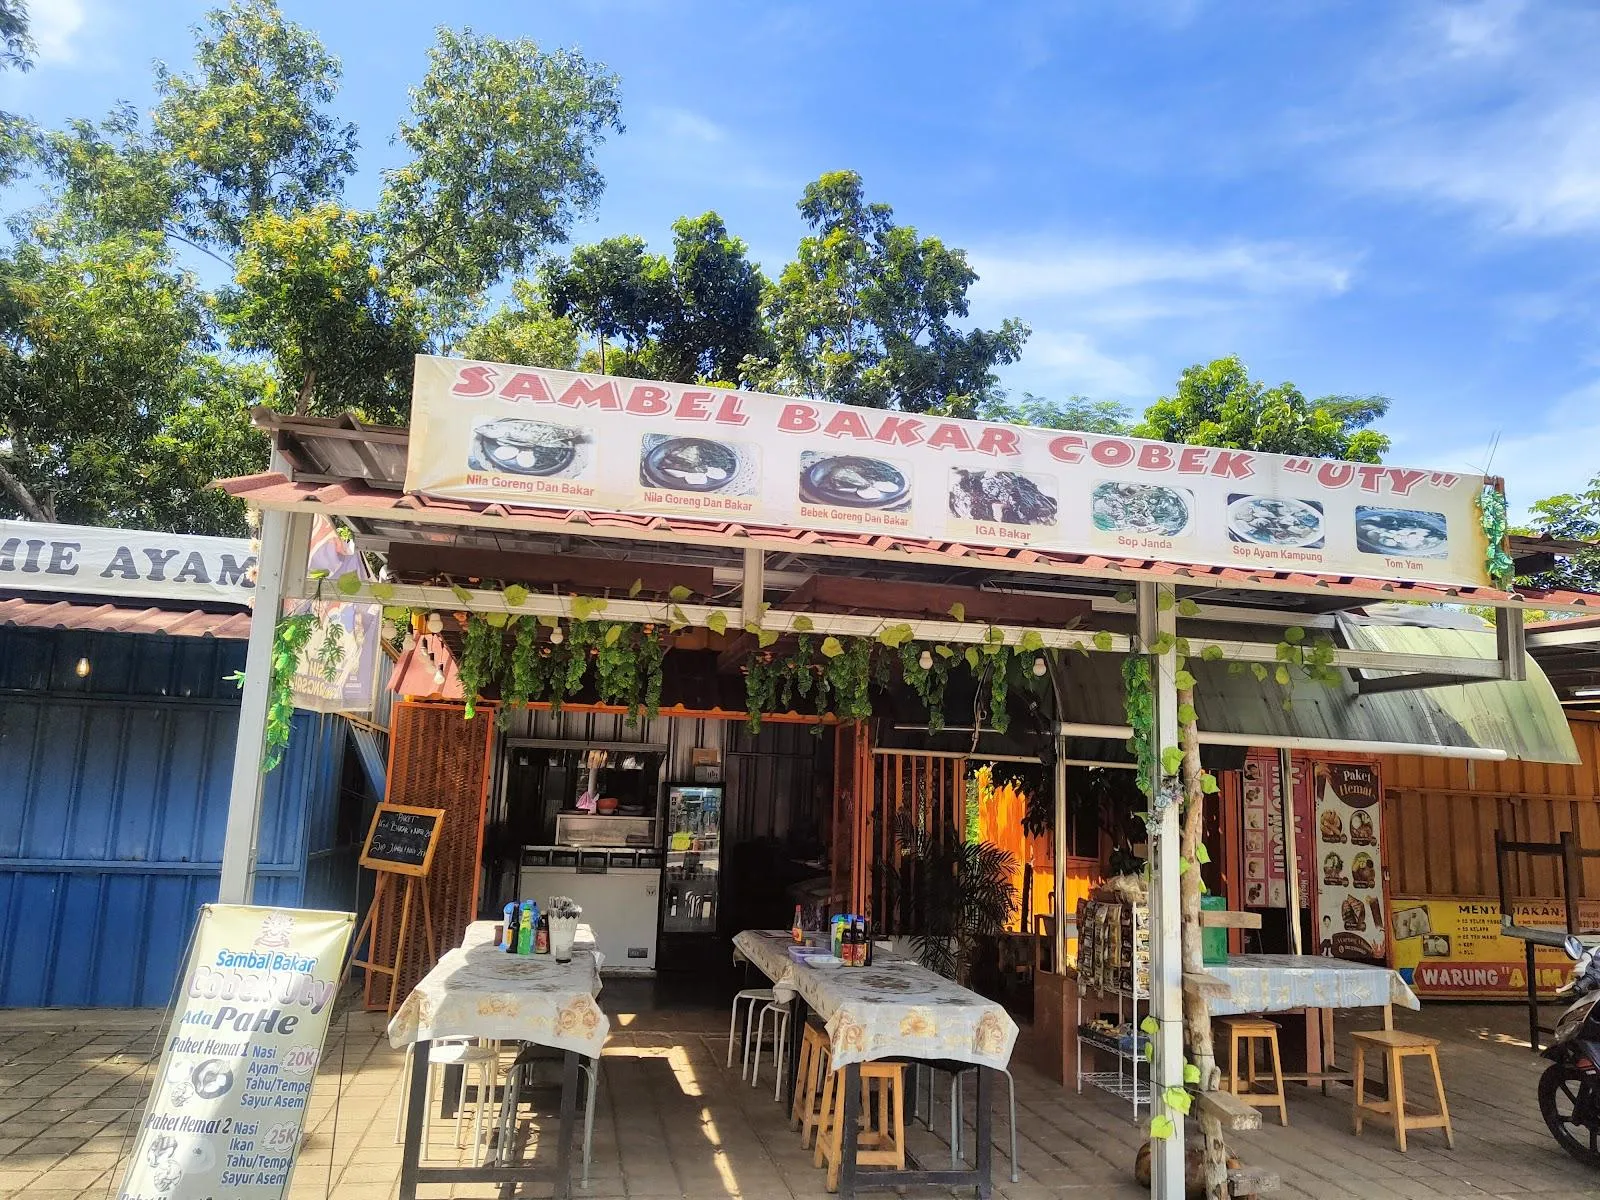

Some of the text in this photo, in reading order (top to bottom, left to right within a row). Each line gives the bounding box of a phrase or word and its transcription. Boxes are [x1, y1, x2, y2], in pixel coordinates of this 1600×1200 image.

[452, 366, 750, 425] SAMBEL
[776, 404, 1021, 457] BAKAR
[1047, 435, 1255, 480] COBEK
[466, 474, 595, 497] Nila Goreng Dan Bakar
[643, 491, 753, 511] Nila Goreng Dan Bakar
[801, 506, 909, 527] Bebek Goreng Dan Bakar
[975, 525, 1031, 540] IGA Bakar
[1118, 536, 1173, 549] Sop Janda
[1233, 545, 1323, 563] Sop Ayam Kampung
[100, 545, 257, 588] AYAM
[1384, 558, 1424, 571] Tom Yam
[1343, 768, 1371, 783] Paket
[215, 948, 317, 973] Sambal Bakar
[1421, 967, 1499, 987] WARUNG
[180, 1006, 299, 1035] Ada PaHe
[168, 1036, 249, 1057] Paket Hemat 1
[252, 1045, 277, 1059] Nasi
[287, 1051, 315, 1067] 20K
[248, 1061, 278, 1075] Ayam
[245, 1077, 311, 1094] Tahu/Tempe
[240, 1093, 304, 1109] Sayur Asem
[145, 1113, 232, 1135] Paket Hemat 2
[233, 1121, 259, 1136] Nasi
[229, 1138, 254, 1152] Ikan
[269, 1128, 296, 1146] 25K
[226, 1154, 293, 1170] Tahu/Tempe
[221, 1170, 288, 1186] Sayur Asem
